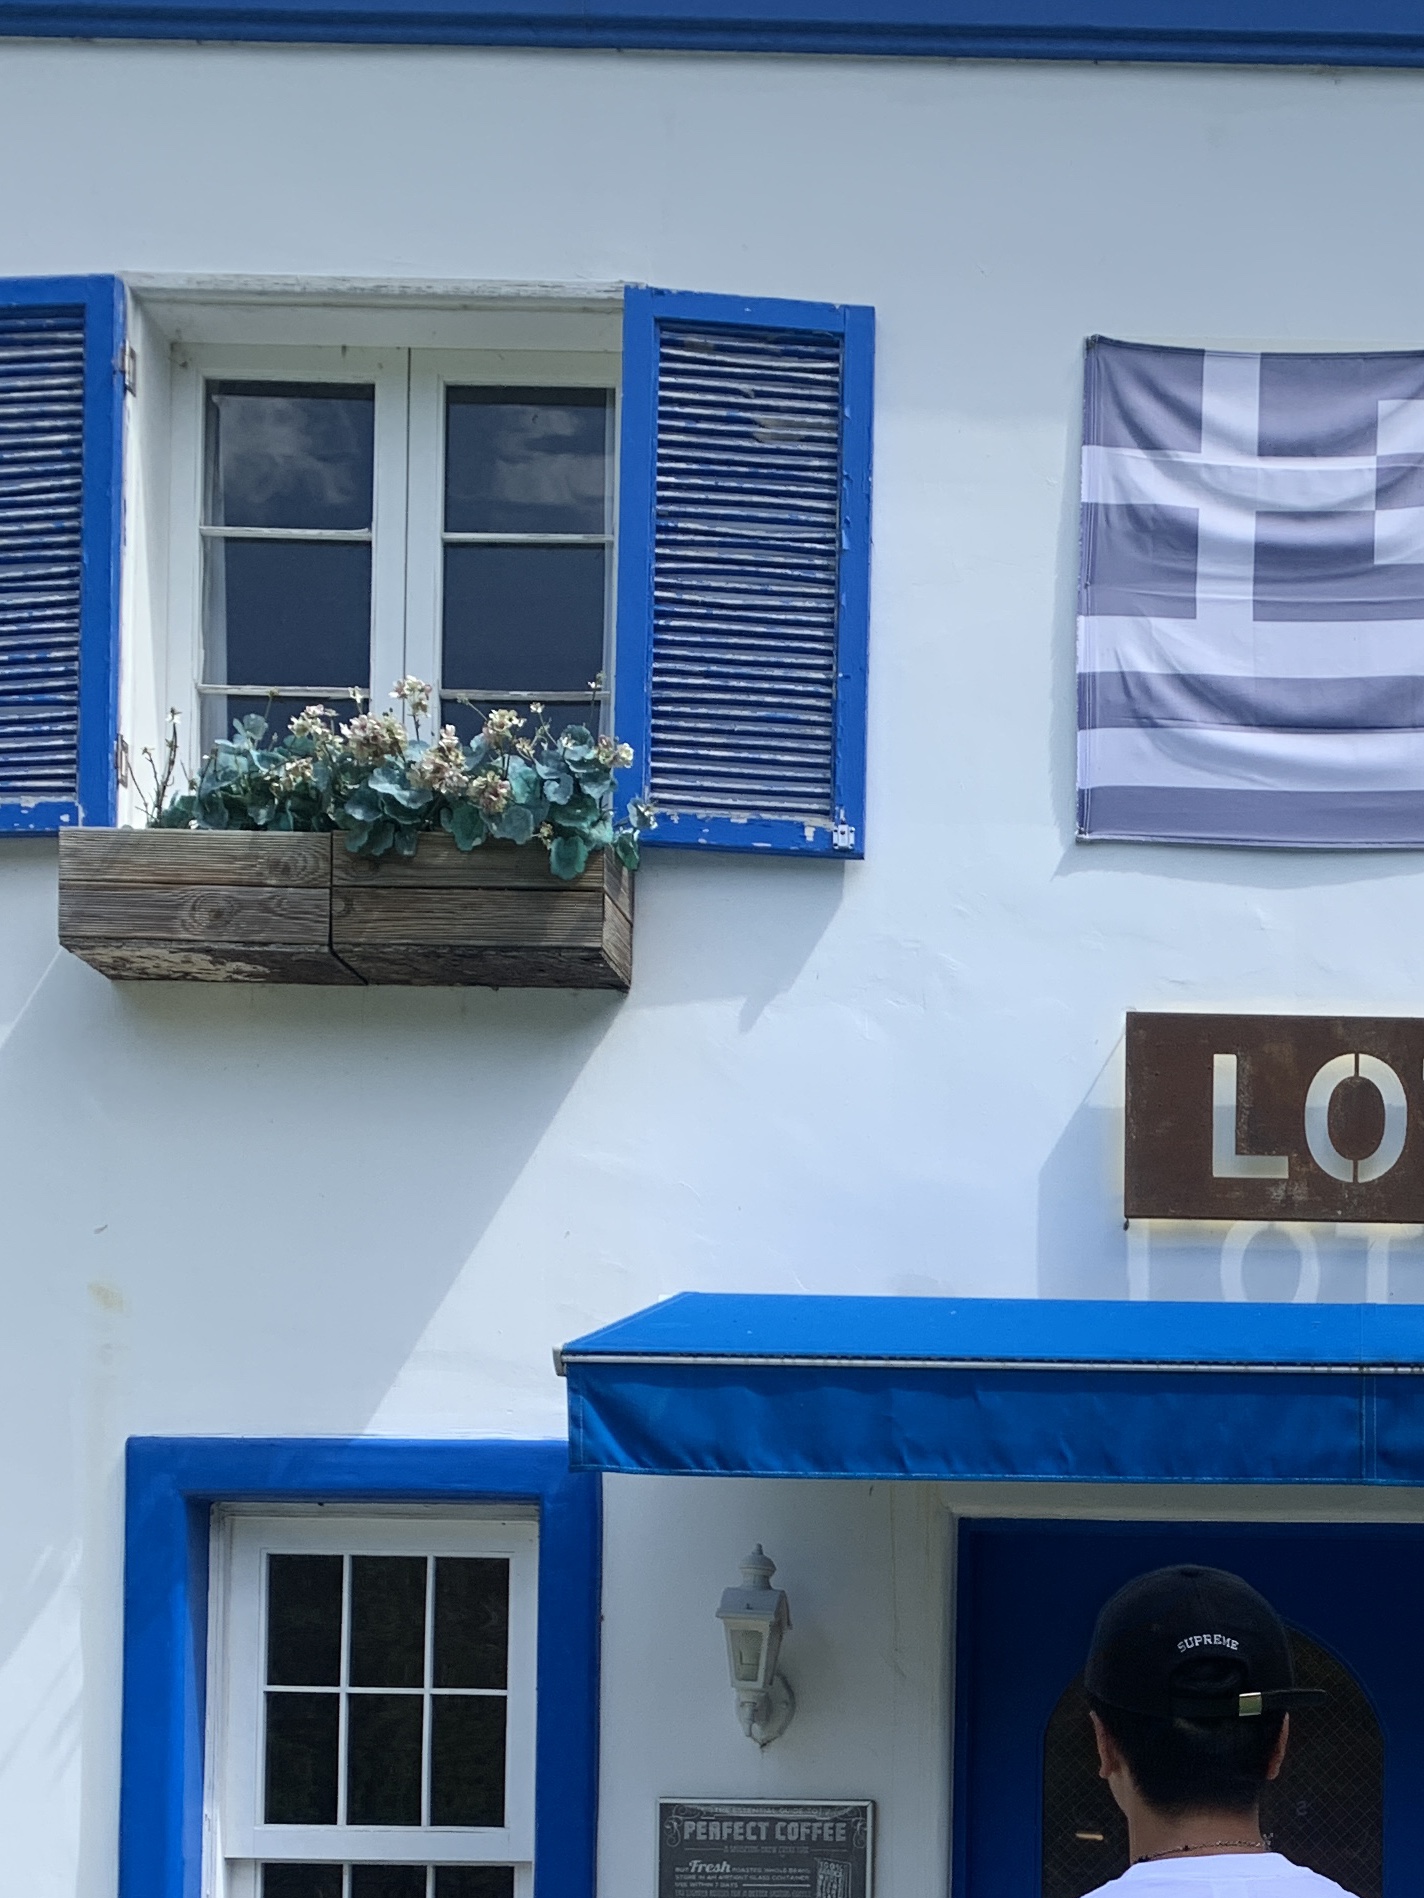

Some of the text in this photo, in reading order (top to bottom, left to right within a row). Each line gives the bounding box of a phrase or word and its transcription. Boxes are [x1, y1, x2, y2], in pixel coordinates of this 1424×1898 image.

[1177, 1633, 1239, 1653] SUPREME
[684, 1821, 846, 1841] PERFECT COFFEE
[689, 1860, 731, 1873] Fresh
